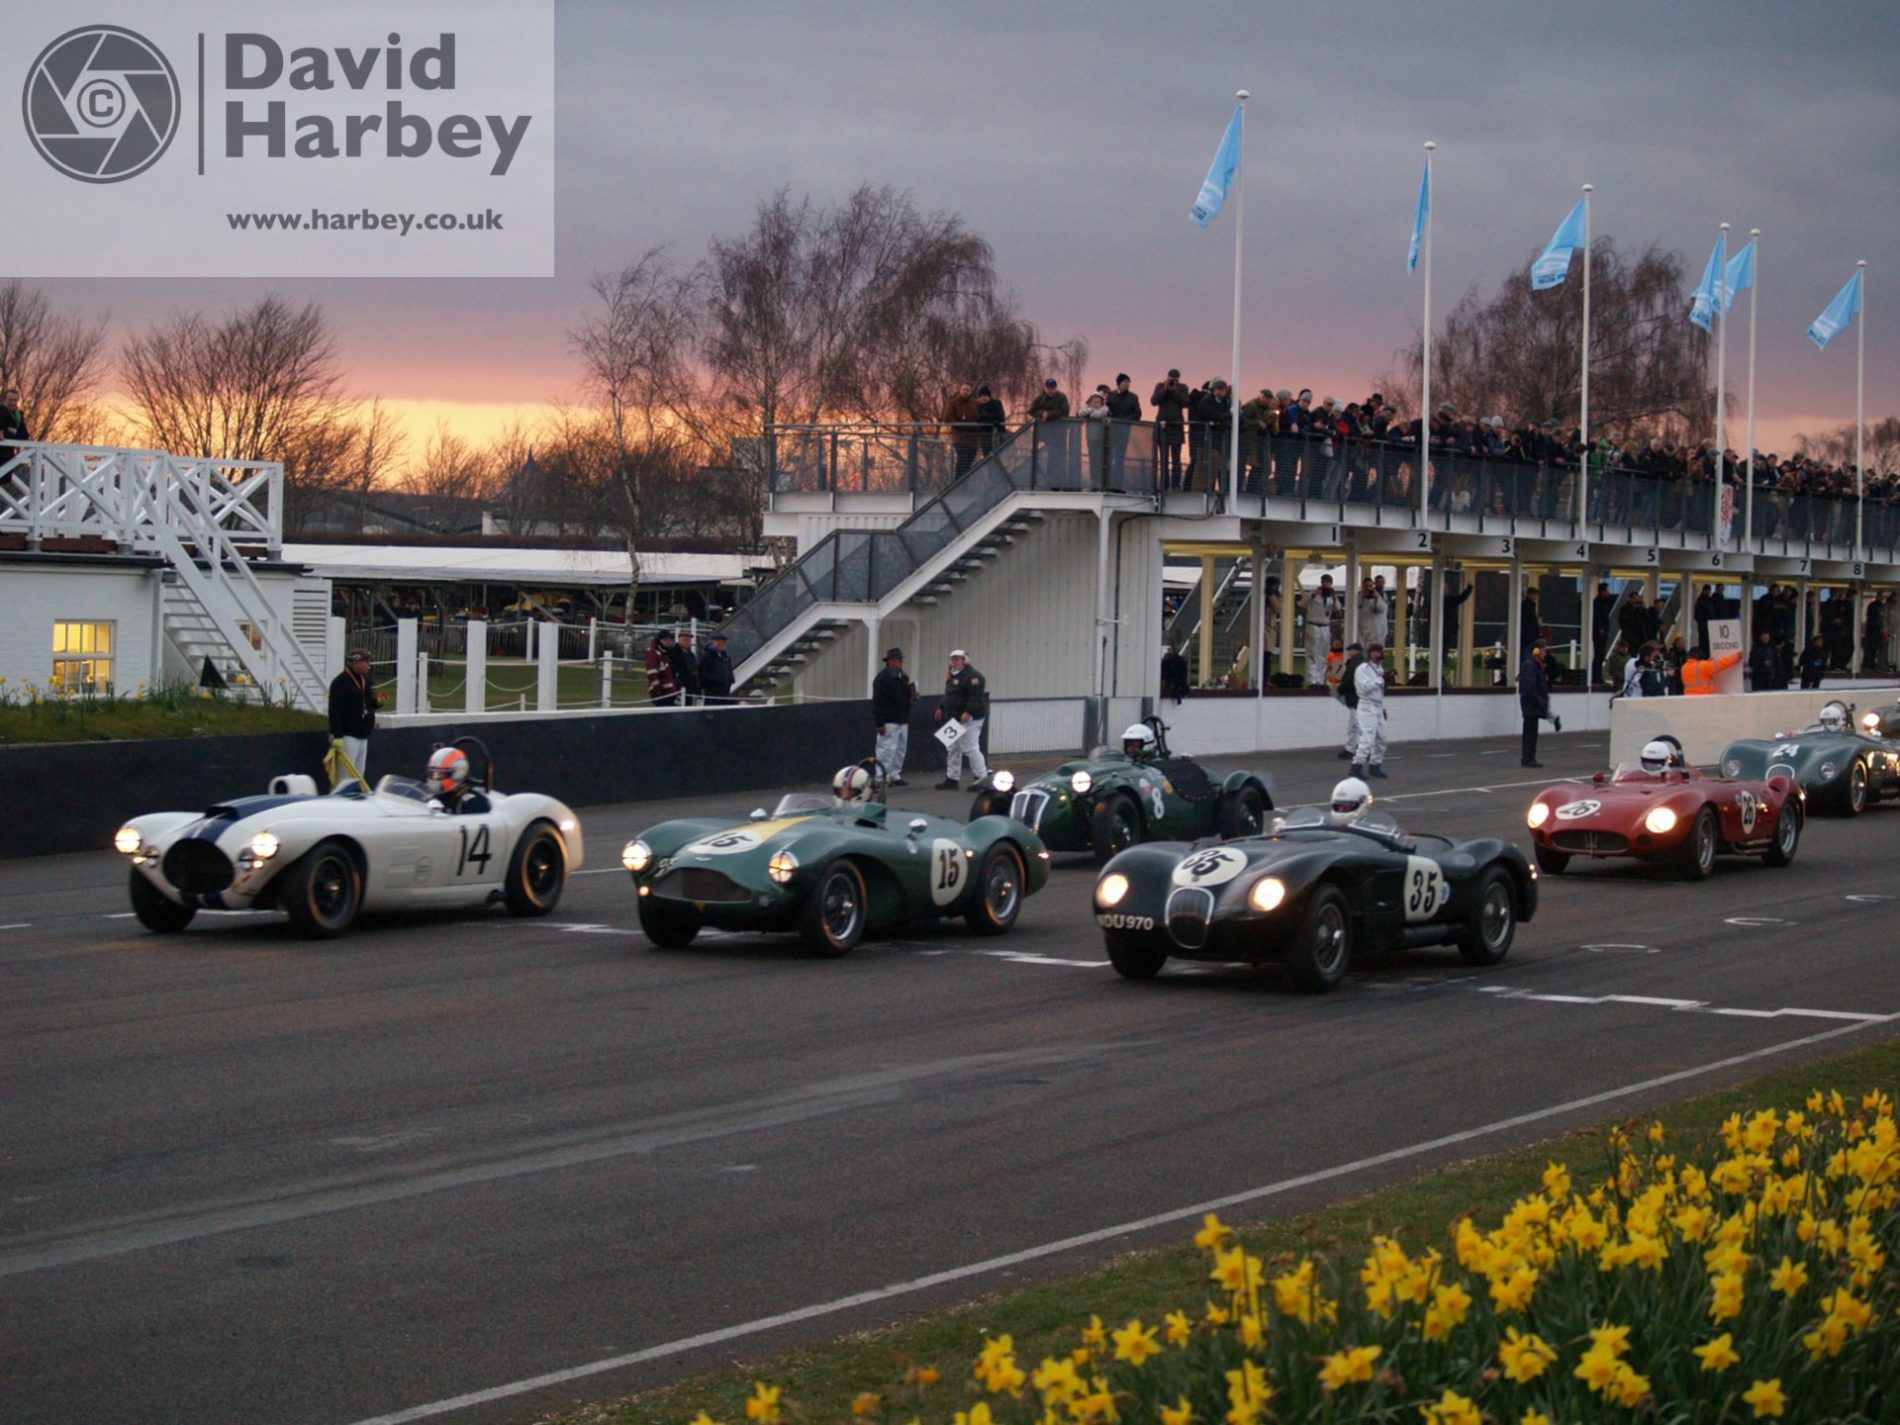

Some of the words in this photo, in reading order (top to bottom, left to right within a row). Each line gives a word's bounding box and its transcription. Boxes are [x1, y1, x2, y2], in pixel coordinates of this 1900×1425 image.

[1417, 532, 1428, 548] 2
[1501, 539, 1511, 553] 3
[1576, 544, 1585, 557] 4
[1647, 549, 1656, 562] 5
[1711, 555, 1721, 566] 6
[1799, 559, 1808, 571] 7
[1853, 564, 1861, 575] 8
[1719, 624, 1730, 639] 10
[944, 726, 958, 739] 3
[1772, 743, 1800, 757] 24
[1151, 787, 1165, 819] 8
[1559, 801, 1598, 816] 26
[1743, 795, 1754, 825] 26
[698, 831, 753, 848] 15
[456, 823, 493, 877] 14
[938, 848, 959, 890] 15
[1182, 850, 1235, 877] 35
[1410, 869, 1438, 914] 35
